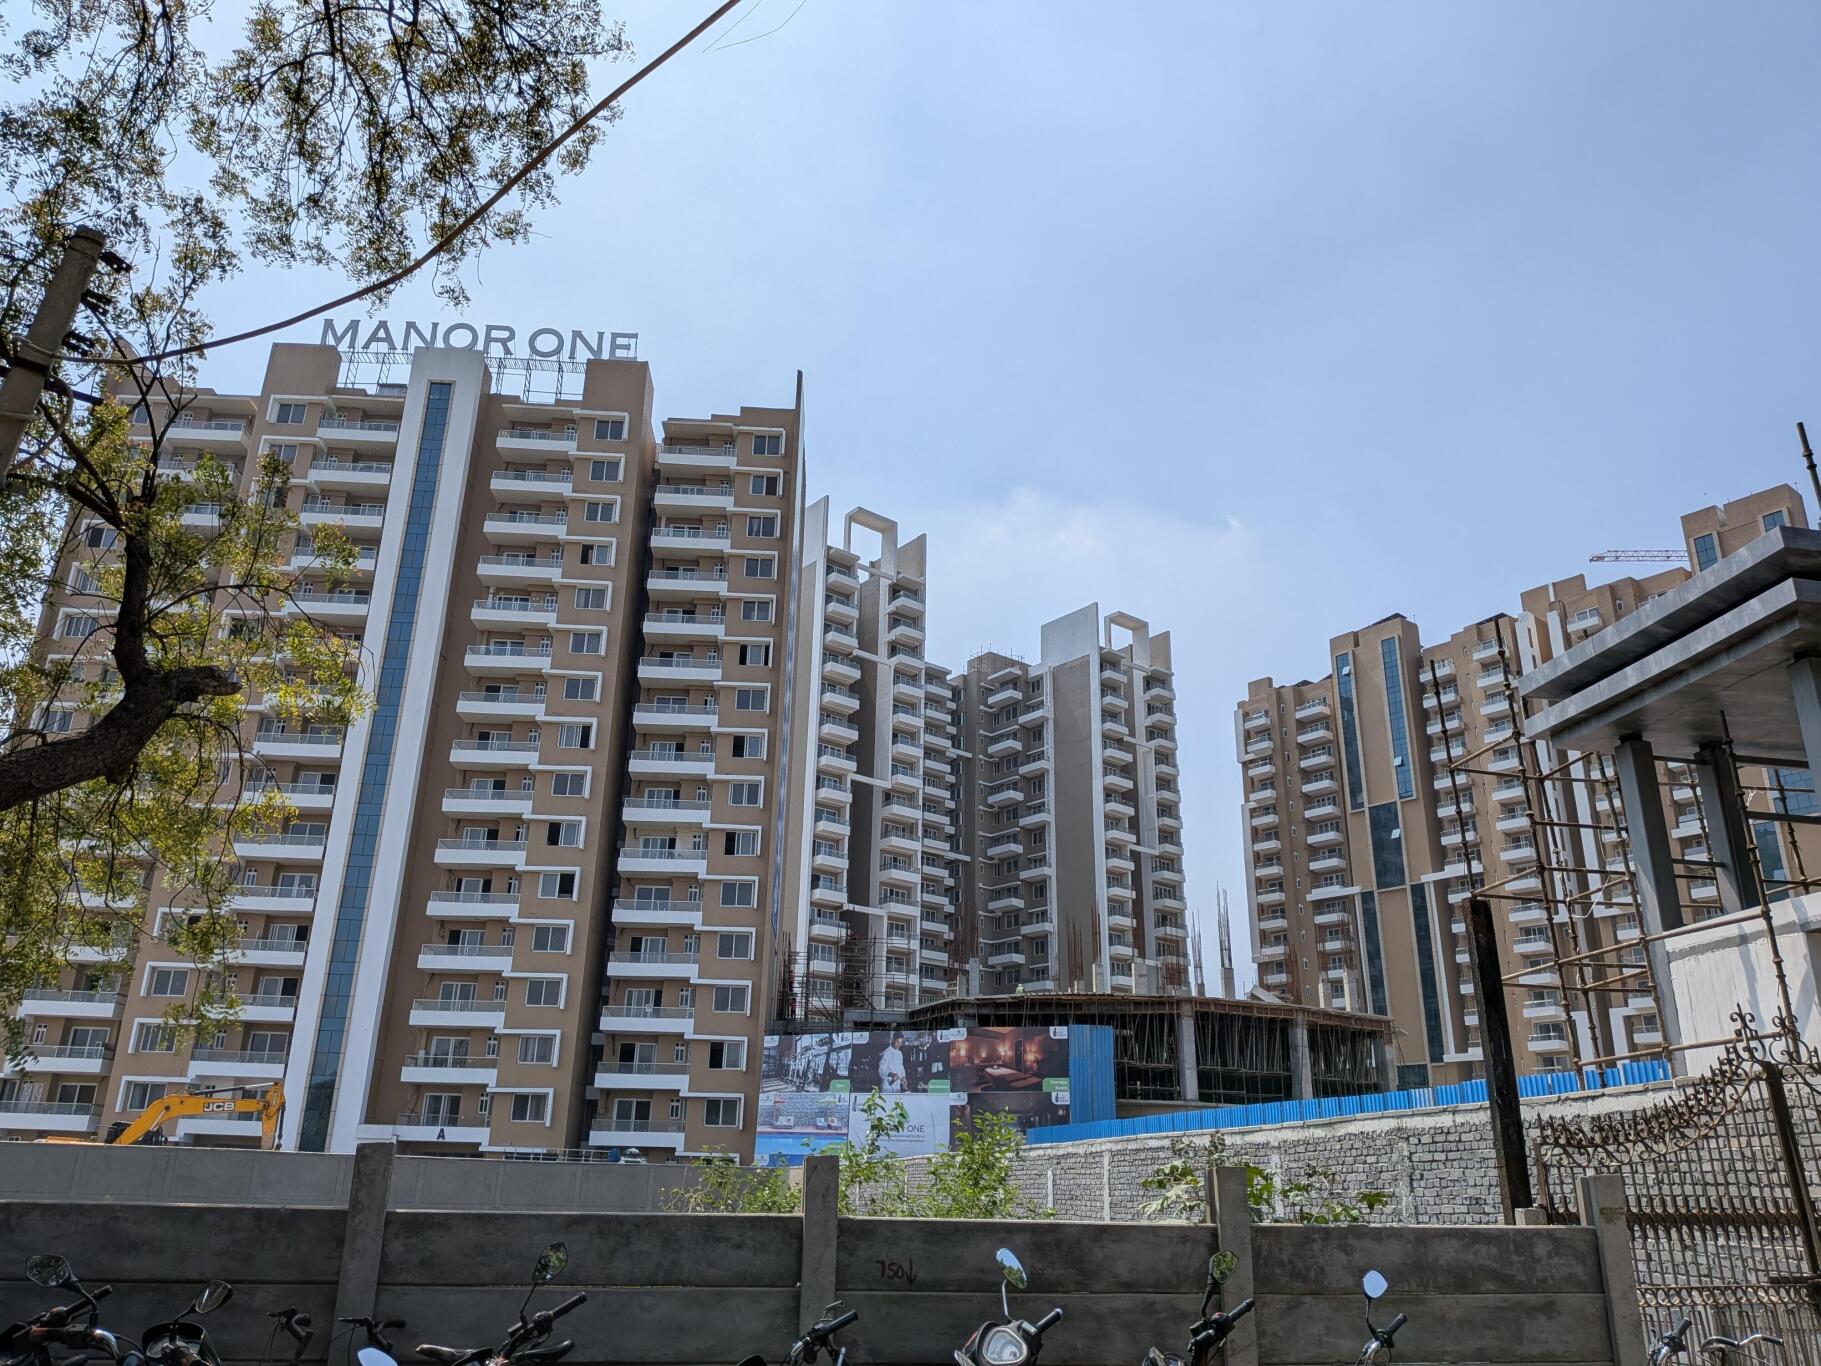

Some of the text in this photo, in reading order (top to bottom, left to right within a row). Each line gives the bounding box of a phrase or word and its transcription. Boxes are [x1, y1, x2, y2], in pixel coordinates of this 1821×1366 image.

[320, 318, 639, 361] MANOR ONE
[204, 1101, 235, 1112] JCB
[436, 1127, 446, 1140] A
[906, 1124, 926, 1133] ONE
